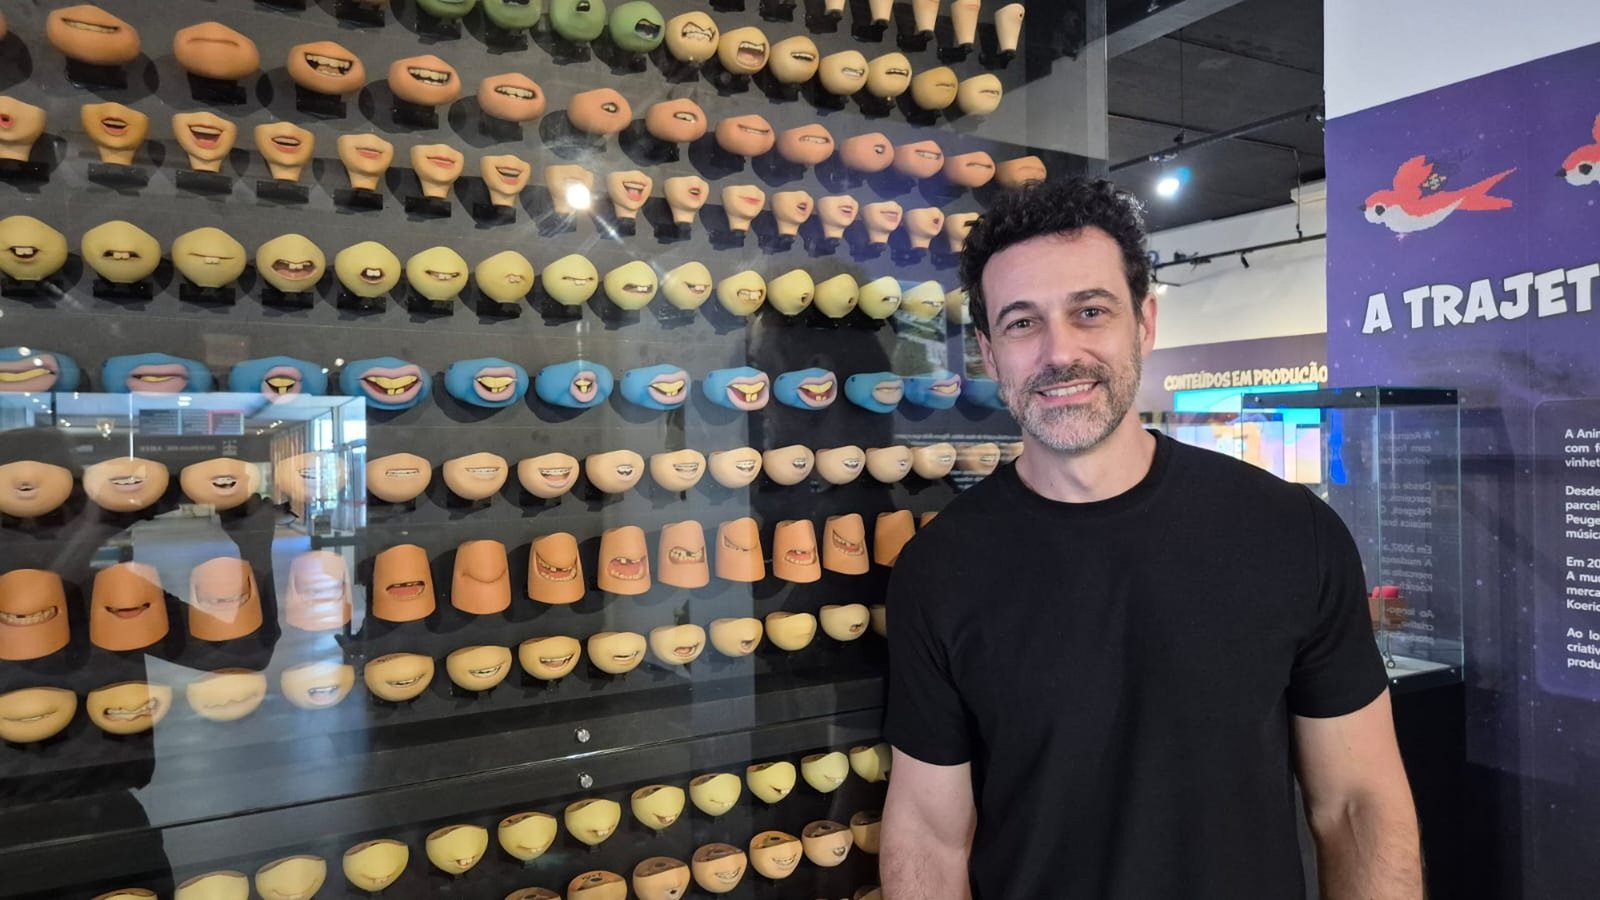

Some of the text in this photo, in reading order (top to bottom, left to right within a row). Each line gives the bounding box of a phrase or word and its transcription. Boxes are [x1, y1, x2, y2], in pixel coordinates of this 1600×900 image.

[1362, 263, 1600, 334] A TRAJET
[1232, 370, 1252, 387] EM
[1565, 428, 1574, 438] A
[1565, 445, 1590, 453] com
[1565, 485, 1600, 496] Desde
[1565, 500, 1600, 512] parcei
[1566, 514, 1600, 528] Peuge
[1566, 528, 1600, 540] músic
[1566, 556, 1585, 567] Em
[1566, 570, 1575, 581] A
[1566, 587, 1600, 598] merca
[1567, 627, 1583, 639] Ao
[1567, 658, 1600, 670] produ
